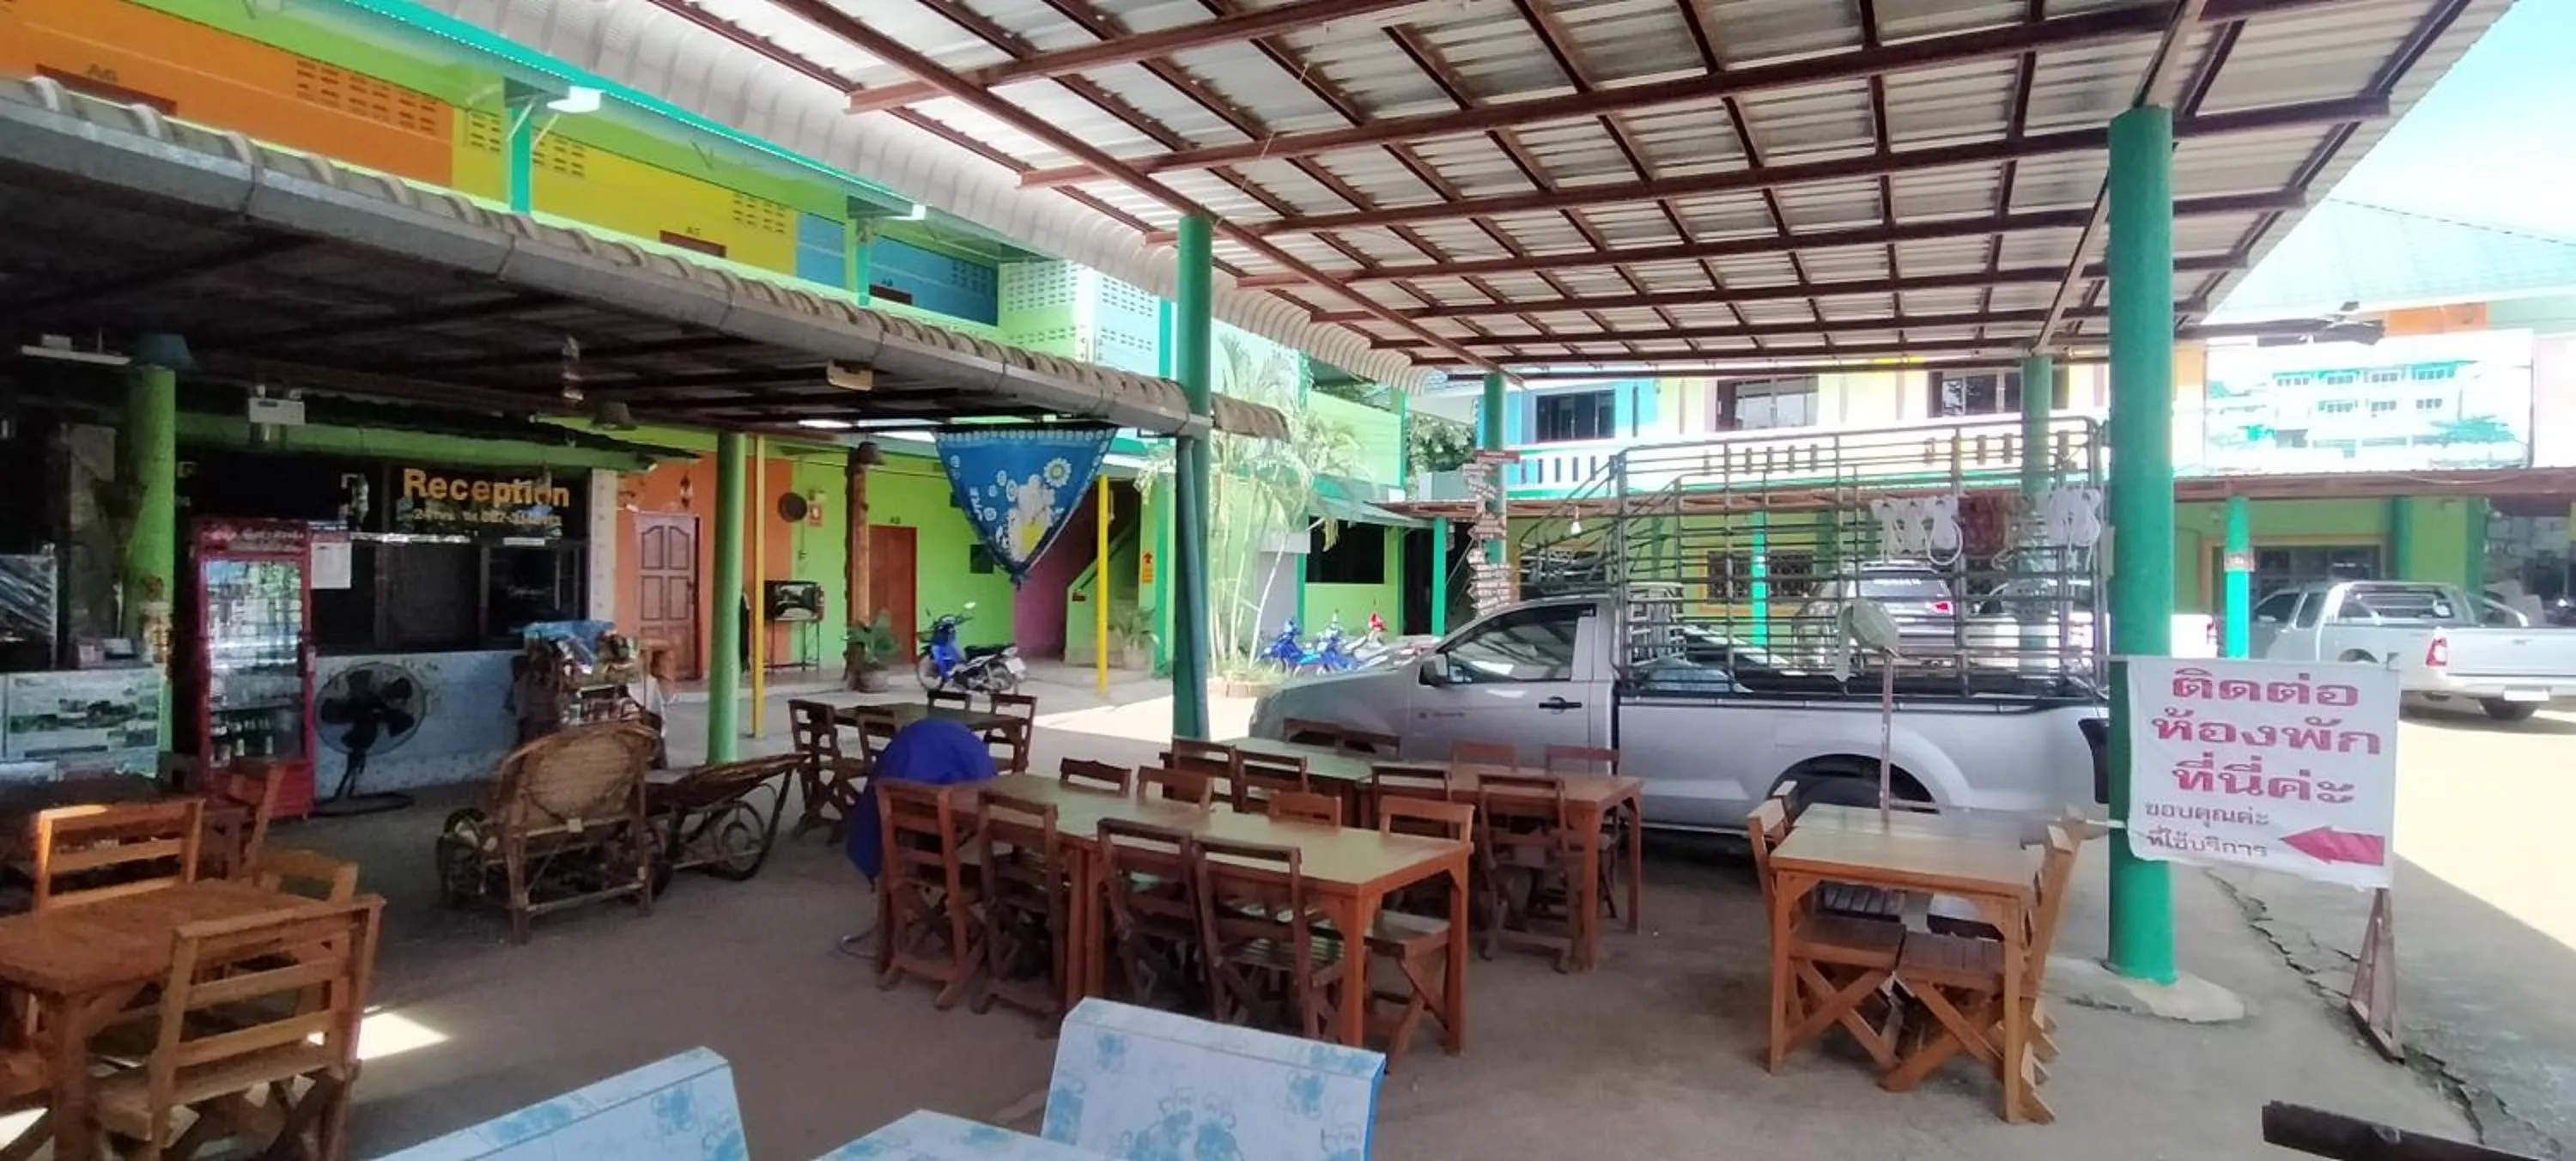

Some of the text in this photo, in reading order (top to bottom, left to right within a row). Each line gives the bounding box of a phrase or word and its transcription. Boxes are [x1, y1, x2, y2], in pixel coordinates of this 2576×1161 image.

[403, 469, 569, 508] Reception
[2172, 667, 2359, 707] ติดต่อ
[2150, 707, 2381, 755] ห้องพัก
[2172, 751, 2355, 804] ที่นี่ค่ะ
[2145, 802, 2269, 828] ขอบคุณค่ะ
[2146, 825, 2268, 857] ที่ใช้บริการ
